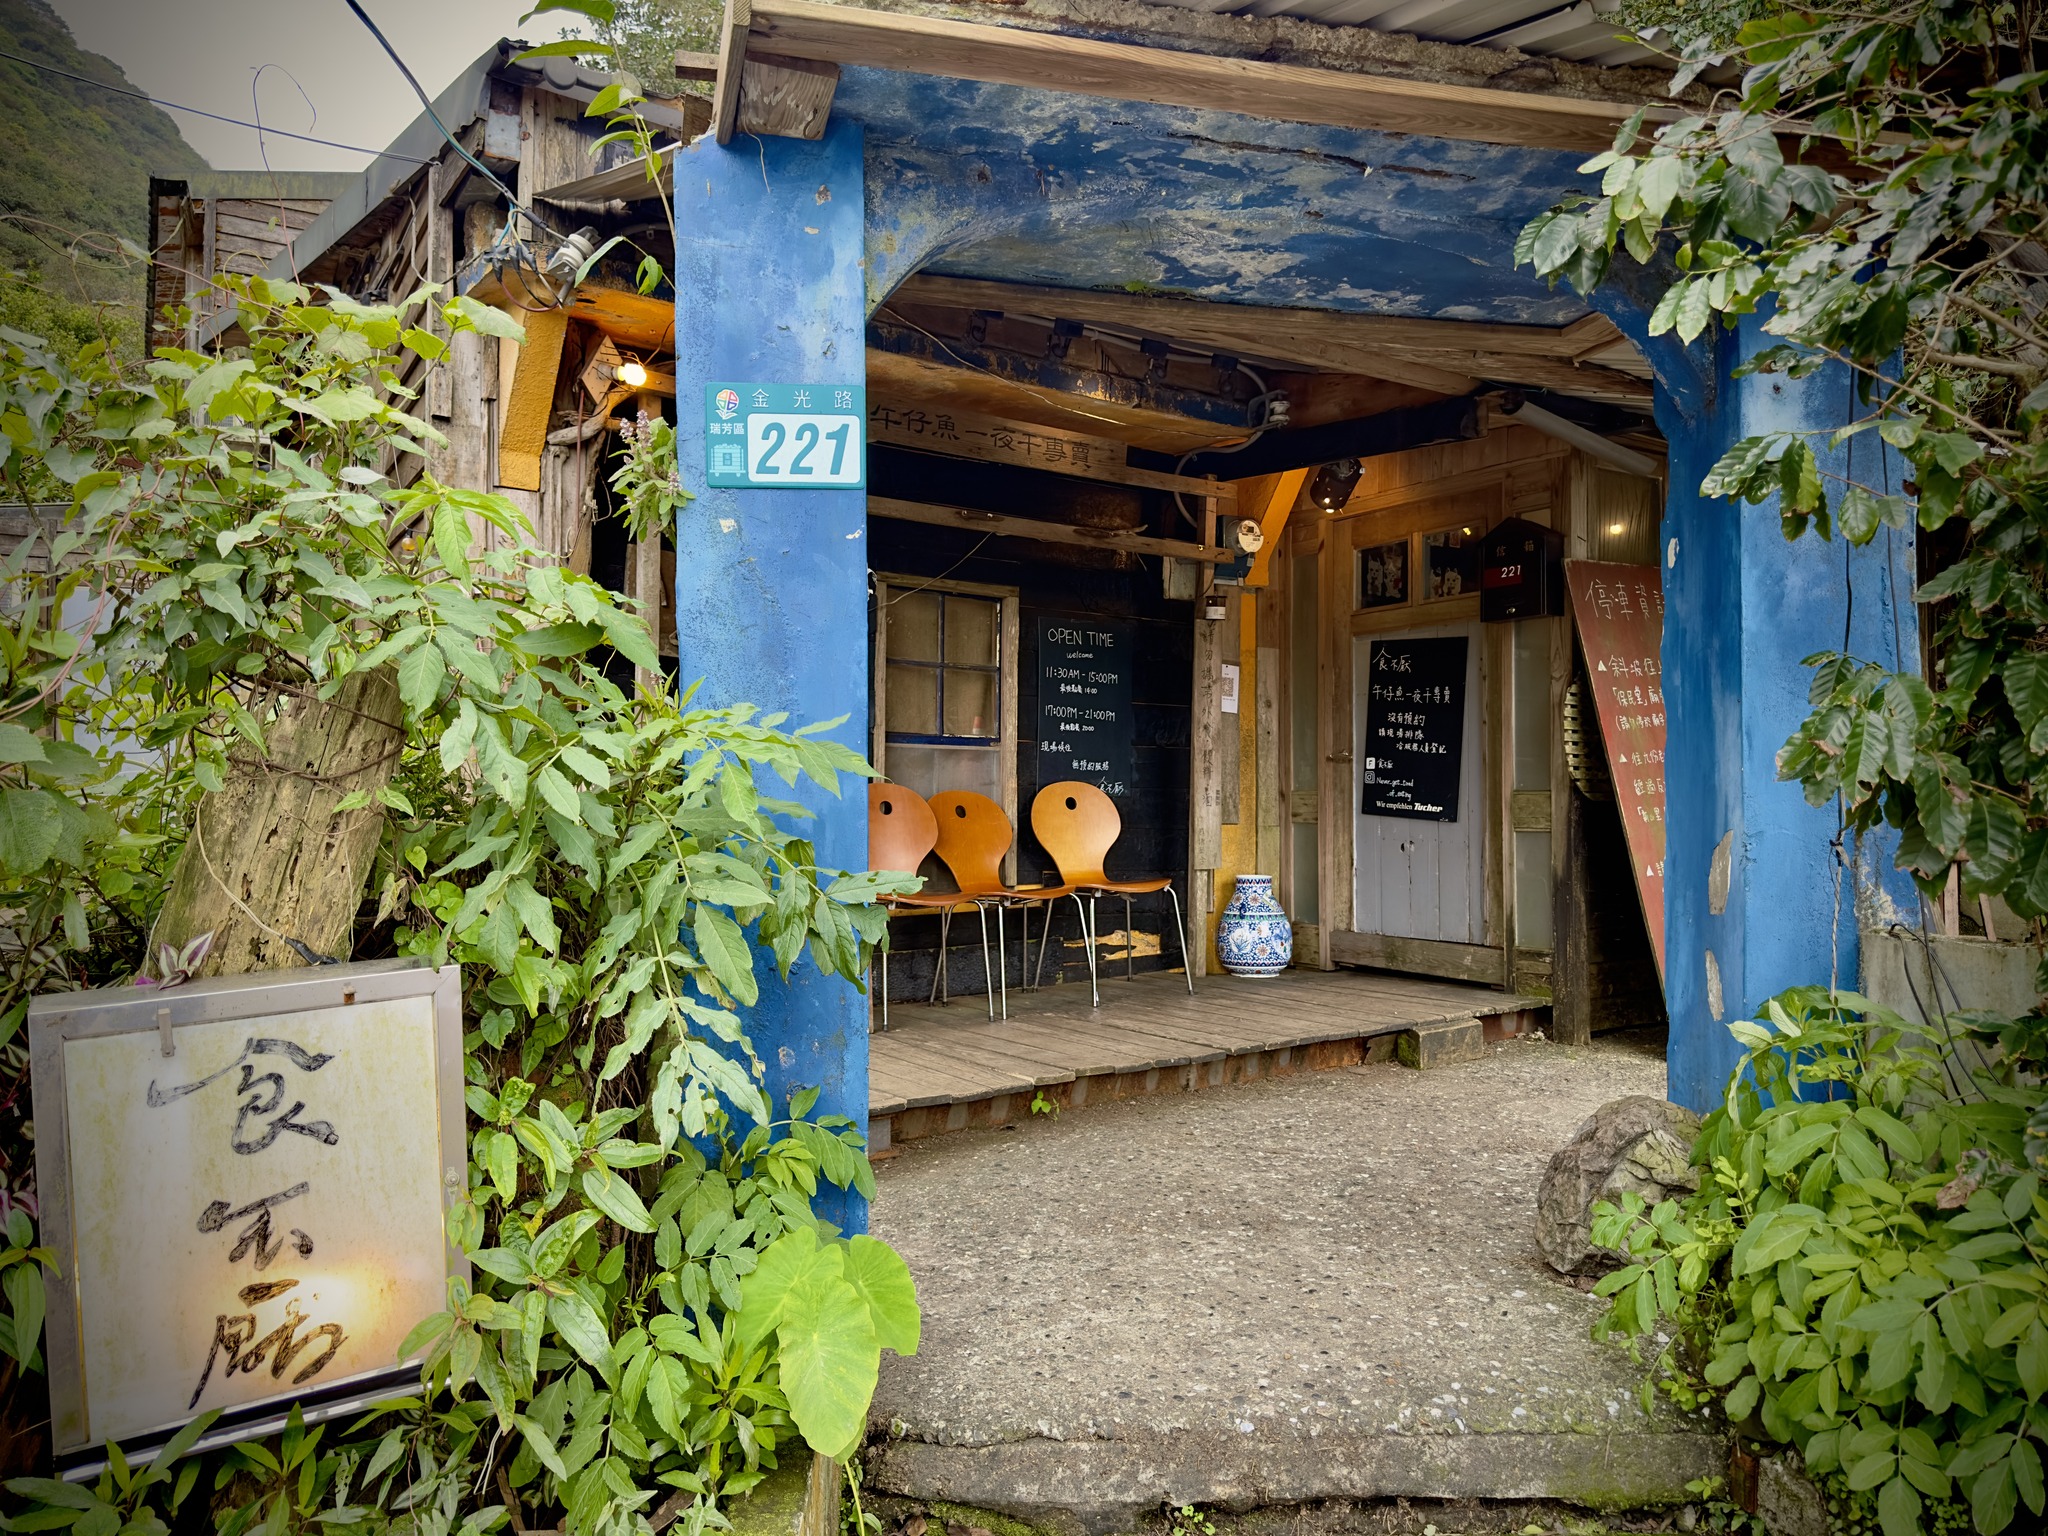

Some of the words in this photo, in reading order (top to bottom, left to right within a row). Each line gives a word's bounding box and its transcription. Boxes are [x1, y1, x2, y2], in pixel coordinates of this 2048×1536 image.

[752, 388, 853, 410] 金光路
[709, 422, 745, 435] 瑞芳區
[870, 403, 1091, 469] 午仔魚一夜干專賣
[755, 422, 850, 475] 221
[1501, 564, 1521, 578] 221
[1048, 628, 1082, 645] OPEN
[1086, 631, 1114, 647] TIME
[1066, 651, 1094, 659] welcome
[1372, 646, 1412, 673] 食不厭
[1045, 666, 1080, 680] 11:30AM
[1088, 671, 1118, 684] 15:00PM
[1372, 684, 1450, 704] 午仔魚一夜干專賣
[1045, 705, 1078, 719] 17:00PM
[1085, 708, 1115, 722] 21:00PM
[1387, 711, 1426, 727] 沒有預約
[1378, 728, 1425, 740] 請現場排隊
[1376, 800, 1386, 808] Wir
[1386, 802, 1413, 810] empfehlen
[1413, 802, 1443, 812] Tucher
